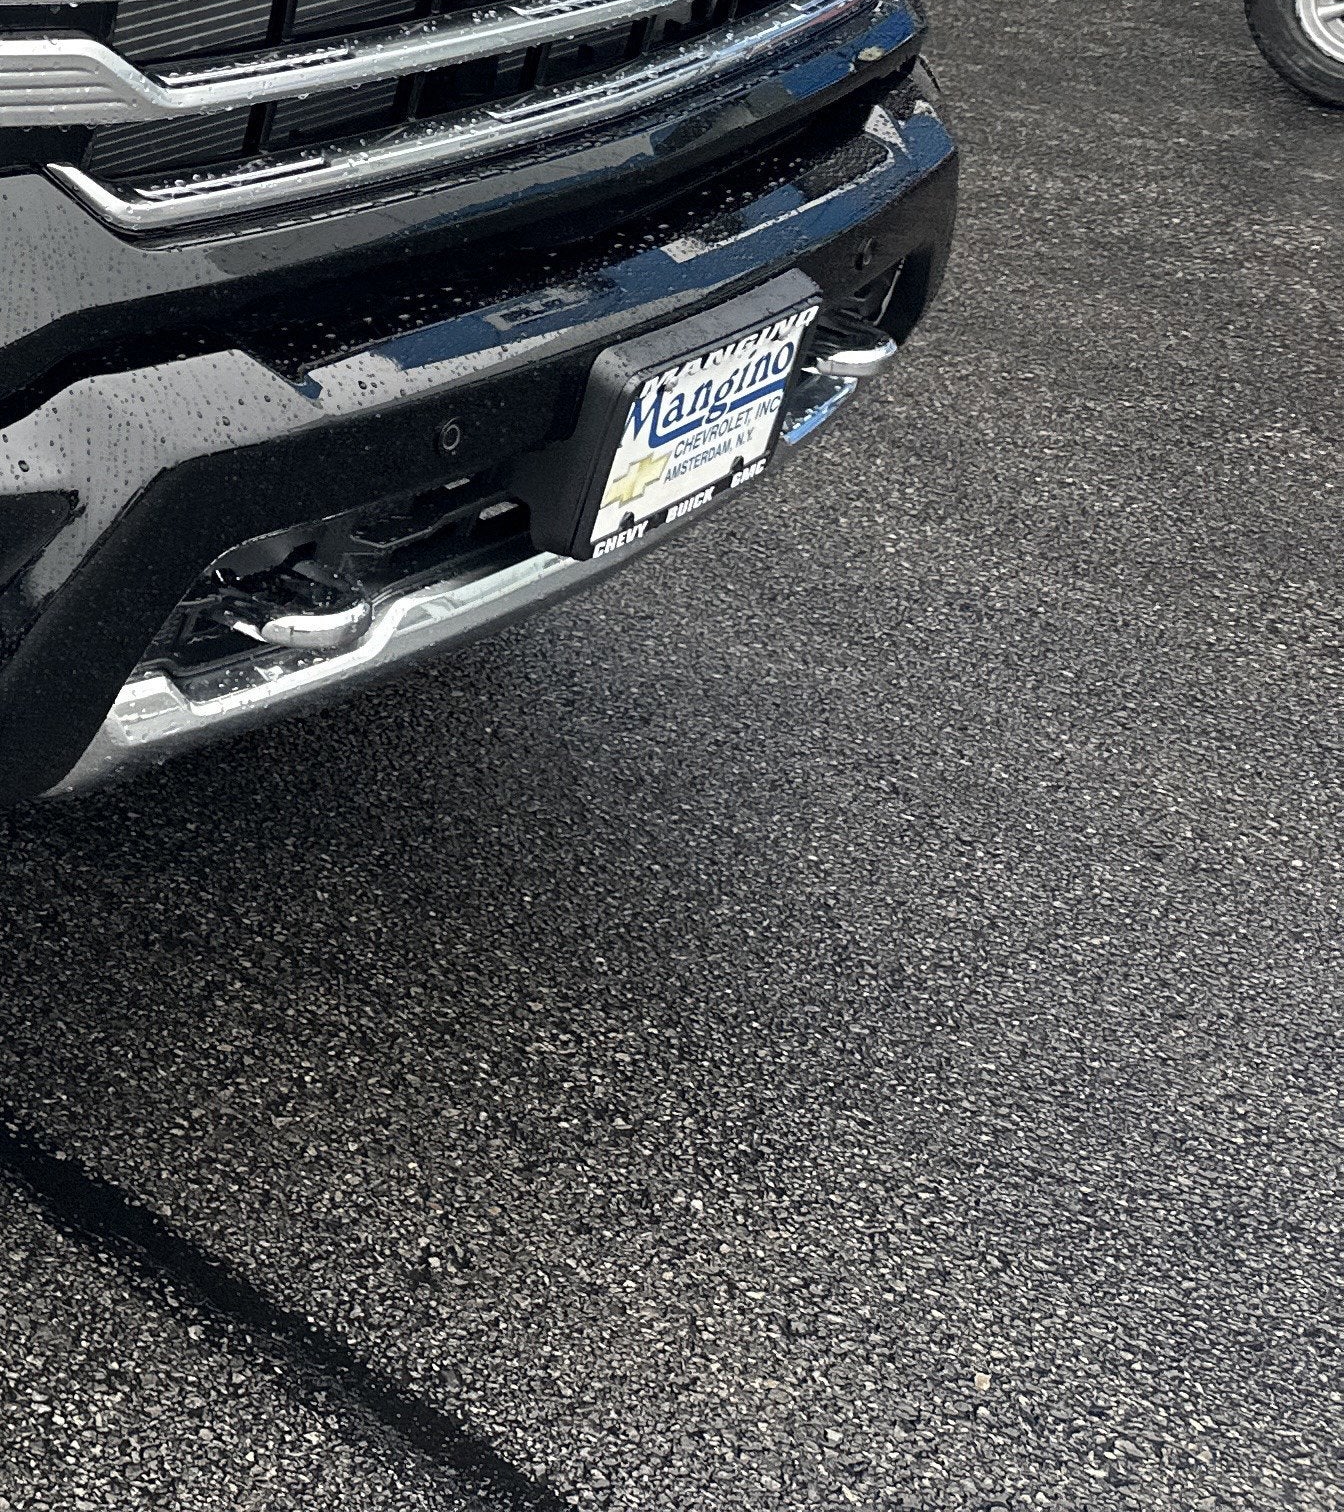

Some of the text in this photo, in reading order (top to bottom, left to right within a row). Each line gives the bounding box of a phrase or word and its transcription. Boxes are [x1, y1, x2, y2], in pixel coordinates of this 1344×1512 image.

[623, 340, 795, 449] Mangino
[592, 458, 767, 559] CHEVY BUICK GMC
